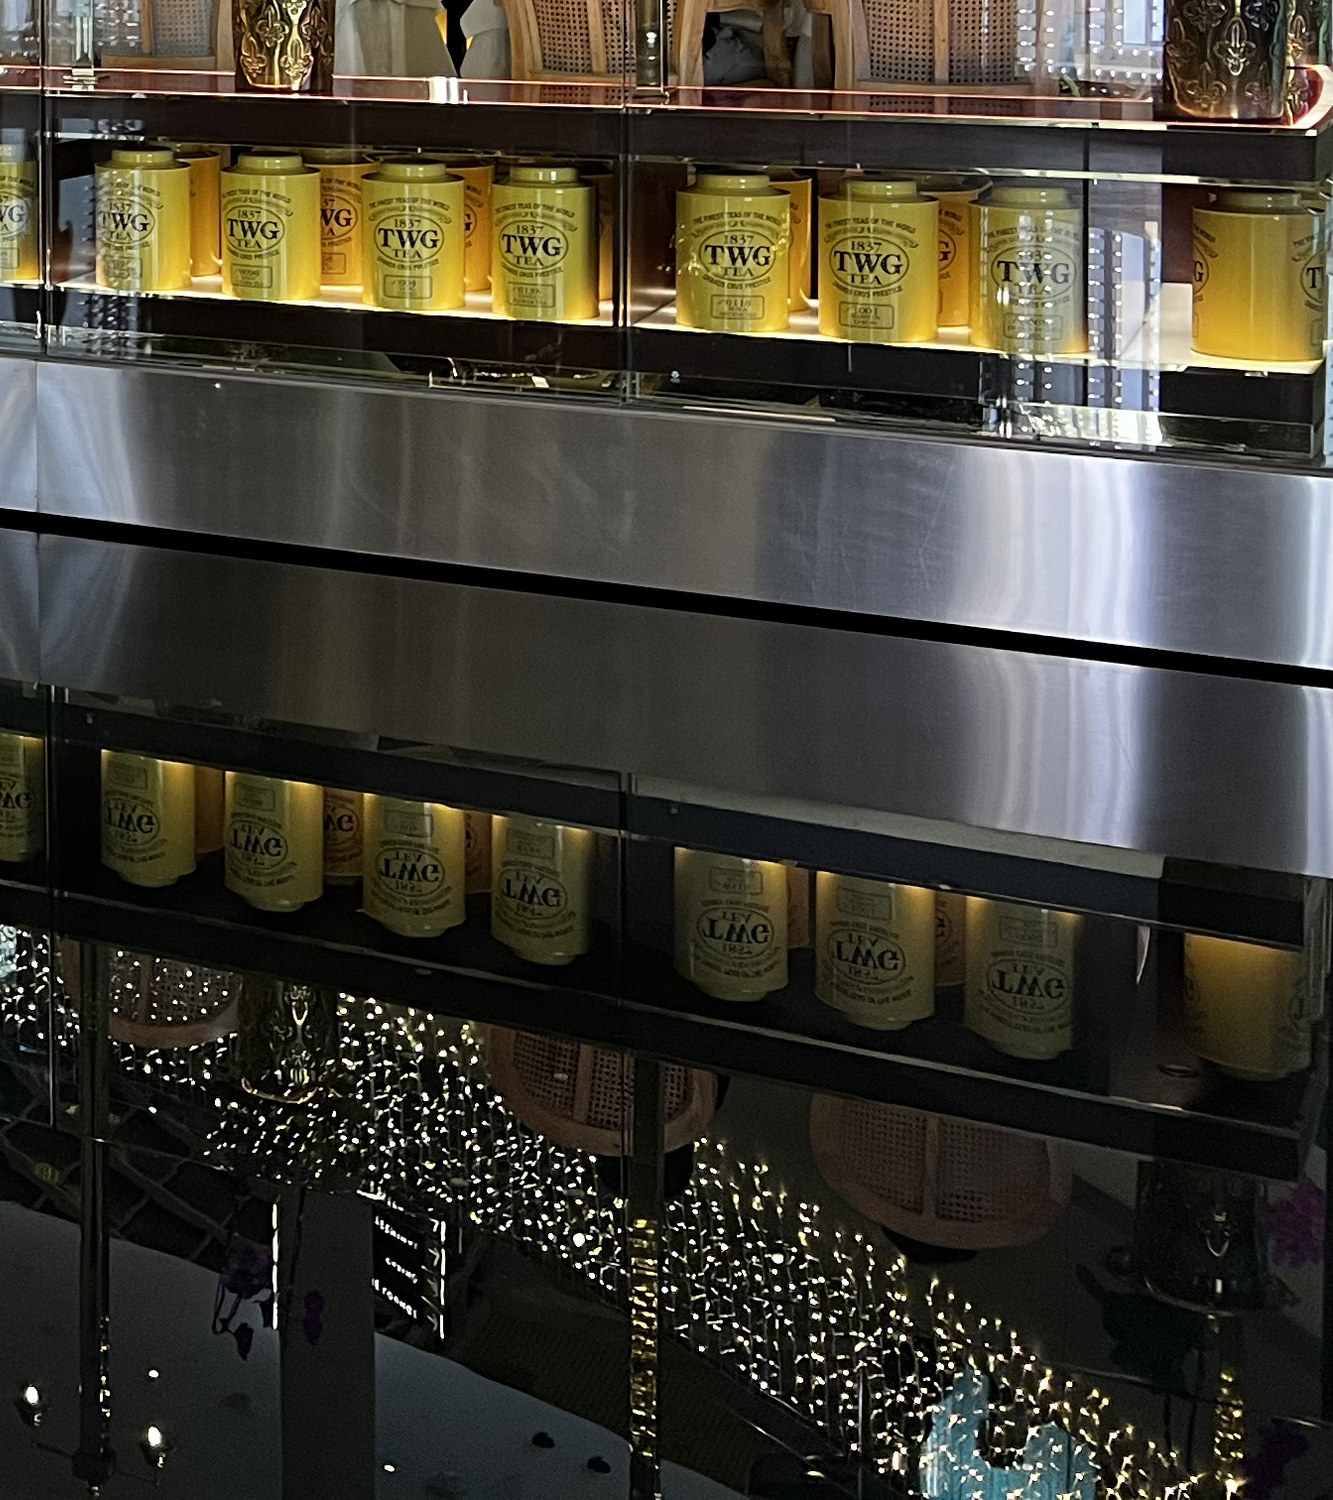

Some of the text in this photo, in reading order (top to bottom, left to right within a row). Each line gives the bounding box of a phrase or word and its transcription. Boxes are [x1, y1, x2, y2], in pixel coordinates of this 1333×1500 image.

[109, 202, 132, 212] 1837
[238, 210, 261, 219] 1837
[321, 208, 353, 227] WG
[99, 212, 150, 232] TWG
[394, 219, 421, 228] 1837
[226, 218, 280, 239] TWG
[516, 225, 544, 235] 1837
[109, 232, 133, 241] TEA
[378, 228, 440, 249] TWG
[723, 234, 754, 245] 1837
[237, 238, 262, 248] TEA
[501, 234, 563, 257] TWG
[851, 241, 882, 252] 1837
[392, 249, 422, 259] TEA
[704, 245, 771, 266] TWG
[513, 255, 544, 266] TEA
[834, 250, 903, 275] TWG
[721, 266, 754, 277] TEA
[997, 260, 1070, 284] TWG
[849, 274, 882, 285] TEA
